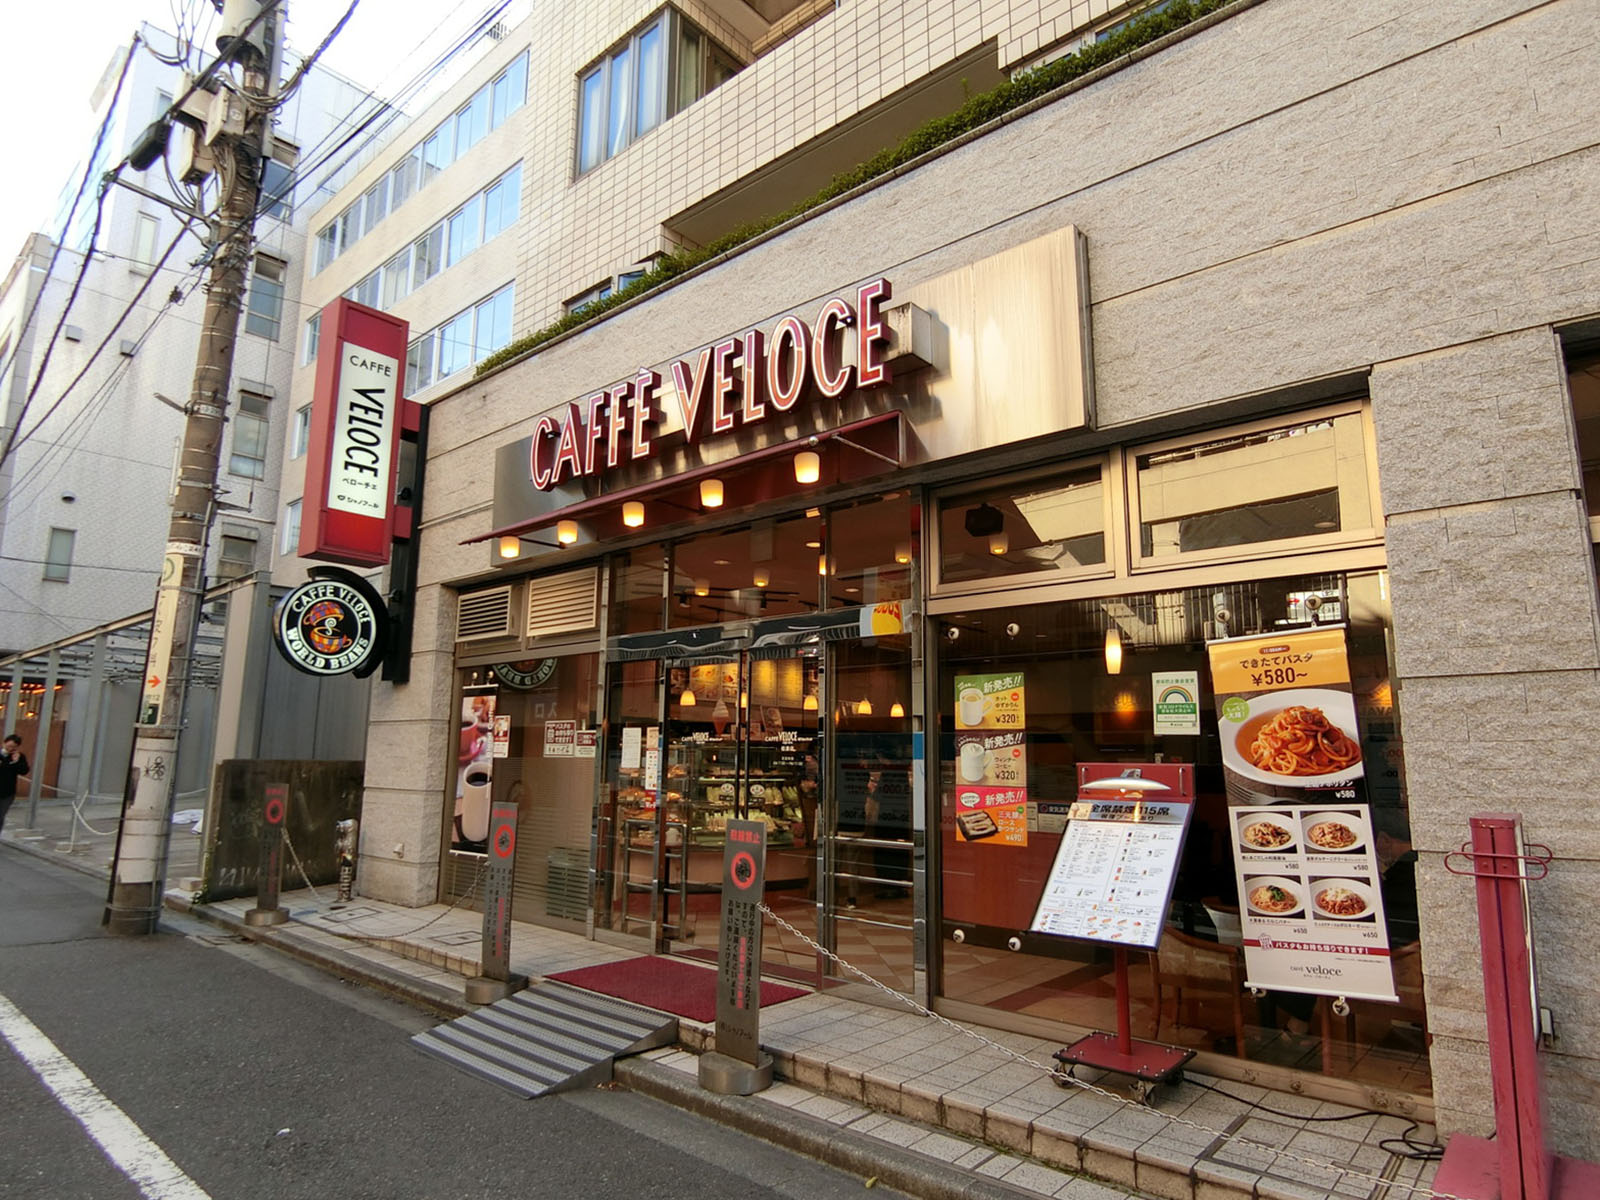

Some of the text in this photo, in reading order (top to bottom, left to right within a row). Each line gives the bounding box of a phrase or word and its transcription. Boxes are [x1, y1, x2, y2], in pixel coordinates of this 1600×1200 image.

[671, 278, 892, 443] VELOCE
[344, 388, 386, 478] VELOCE
[342, 477, 378, 490] ベローチェ
[339, 588, 371, 623] VELOCE
[287, 627, 368, 669] WORLD BEANS
[1239, 653, 1313, 669] できたてパスタ
[983, 675, 1021, 694] 新発売!!
[1251, 667, 1308, 687] ¥580~
[995, 714, 1016, 724] ¥320
[984, 733, 1023, 749] 新発売!!
[995, 770, 1016, 780] ¥320
[985, 791, 1023, 806] 新発売!!
[1305, 965, 1343, 977] veloce
